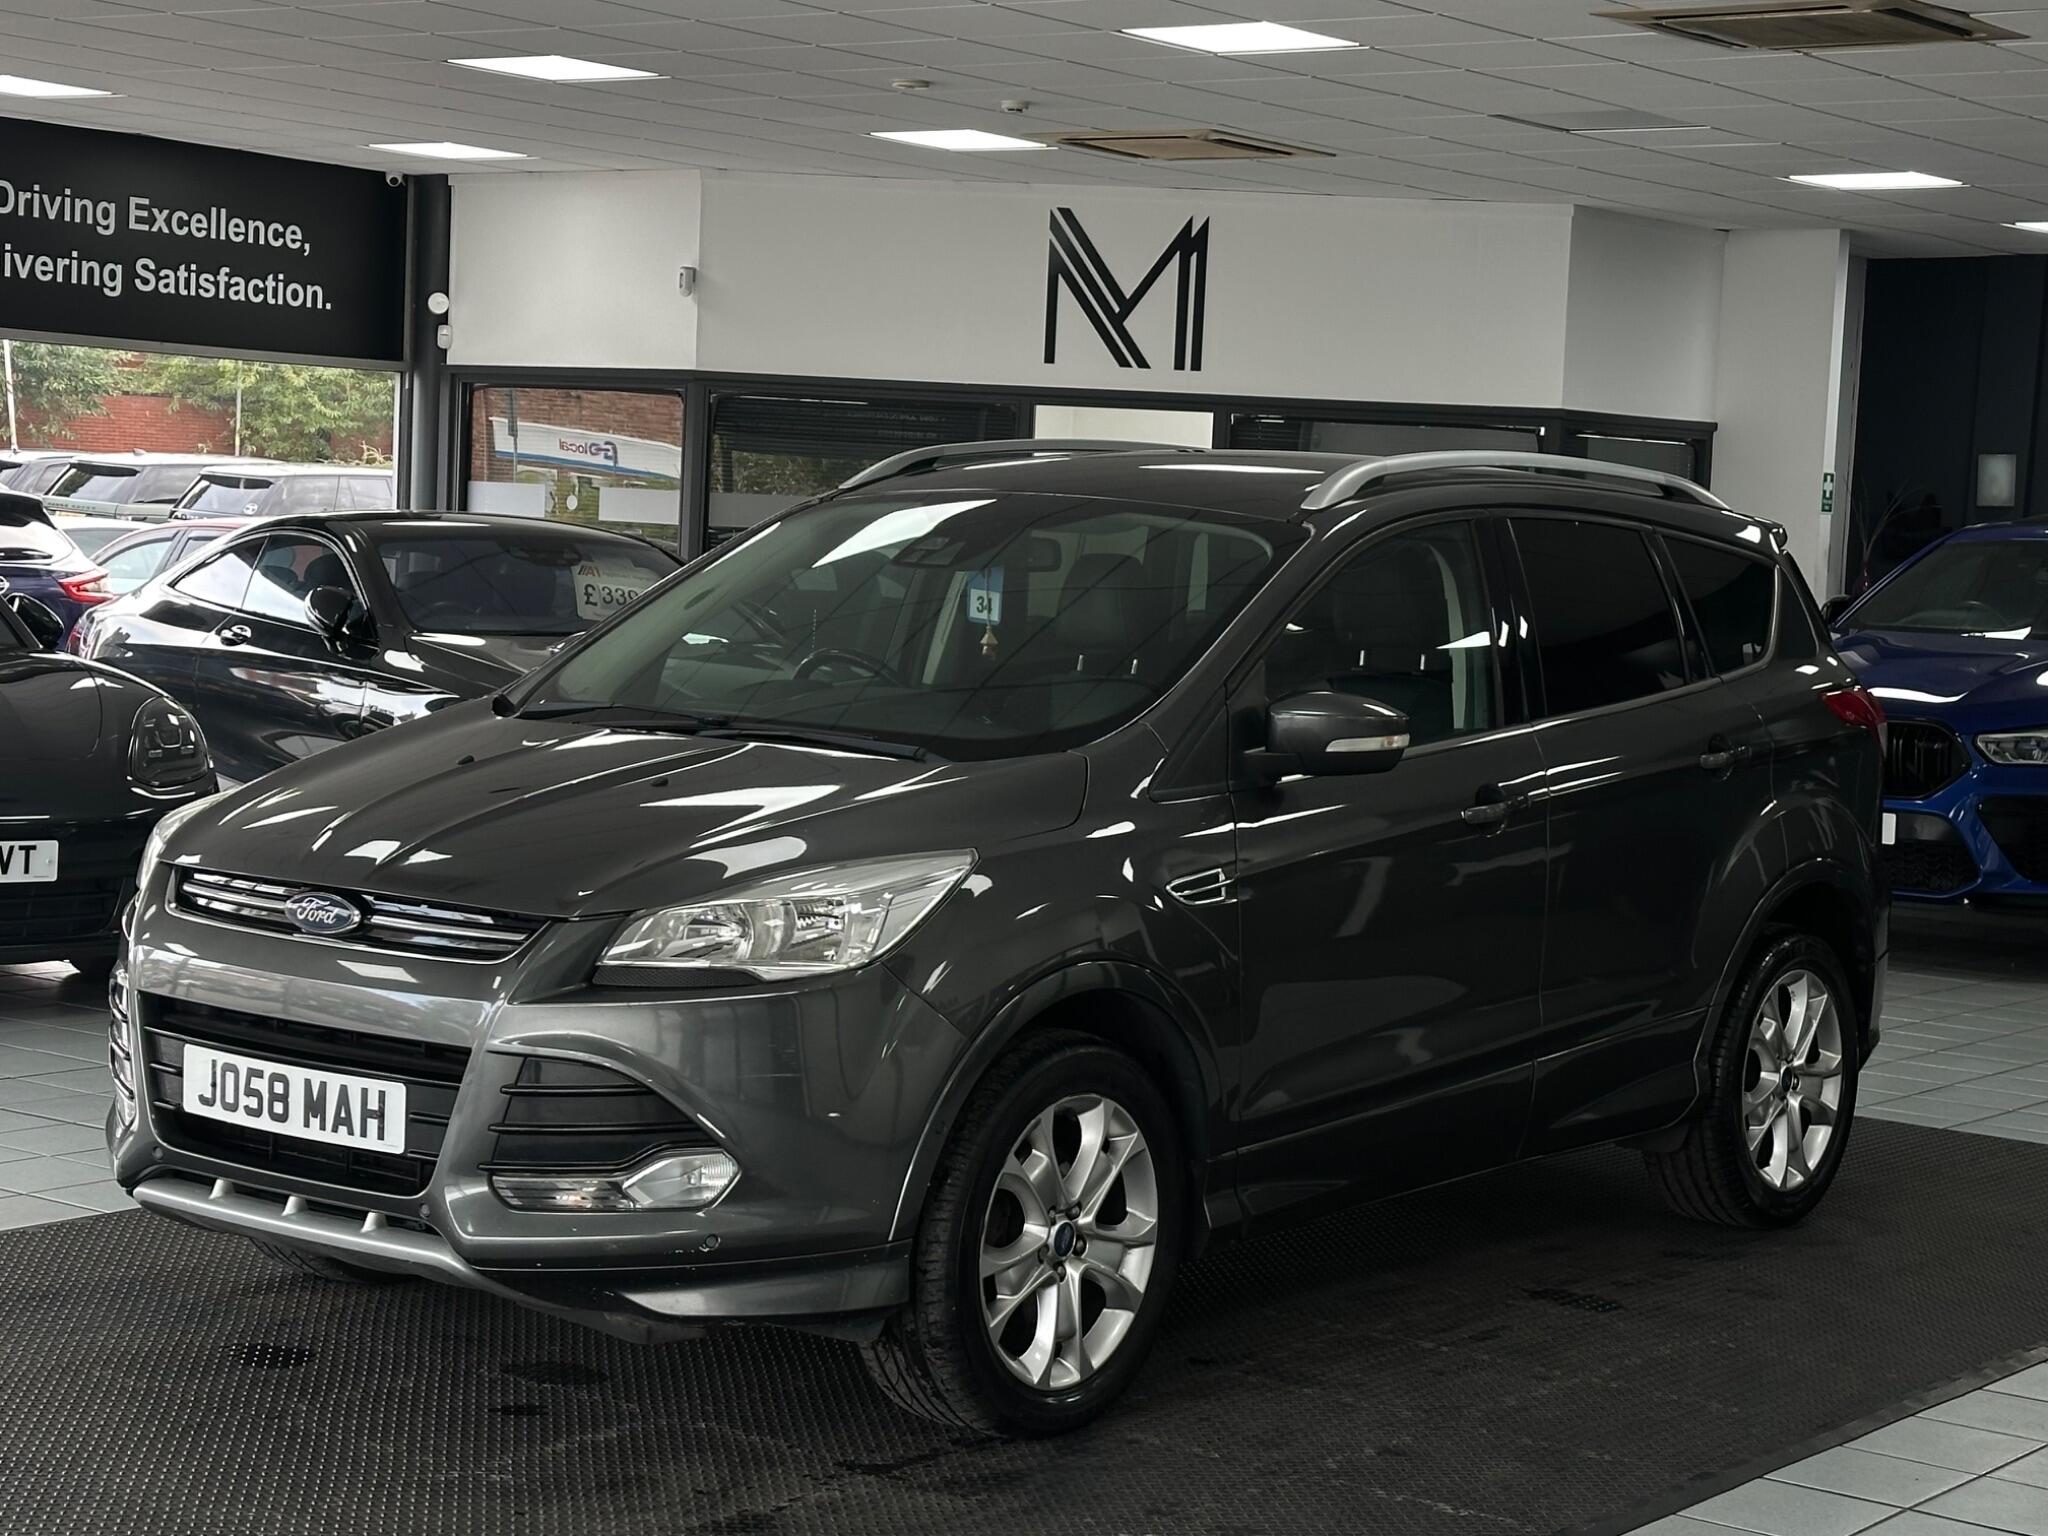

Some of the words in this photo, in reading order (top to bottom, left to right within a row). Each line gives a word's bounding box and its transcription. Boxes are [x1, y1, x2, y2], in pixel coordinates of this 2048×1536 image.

[0, 180, 116, 235] Driving
[129, 196, 310, 255] Excellence,
[134, 257, 332, 310] Satisfaction.
[296, 896, 337, 924] Ford
[198, 1059, 290, 1123] JO58
[303, 1078, 386, 1141] MAH
